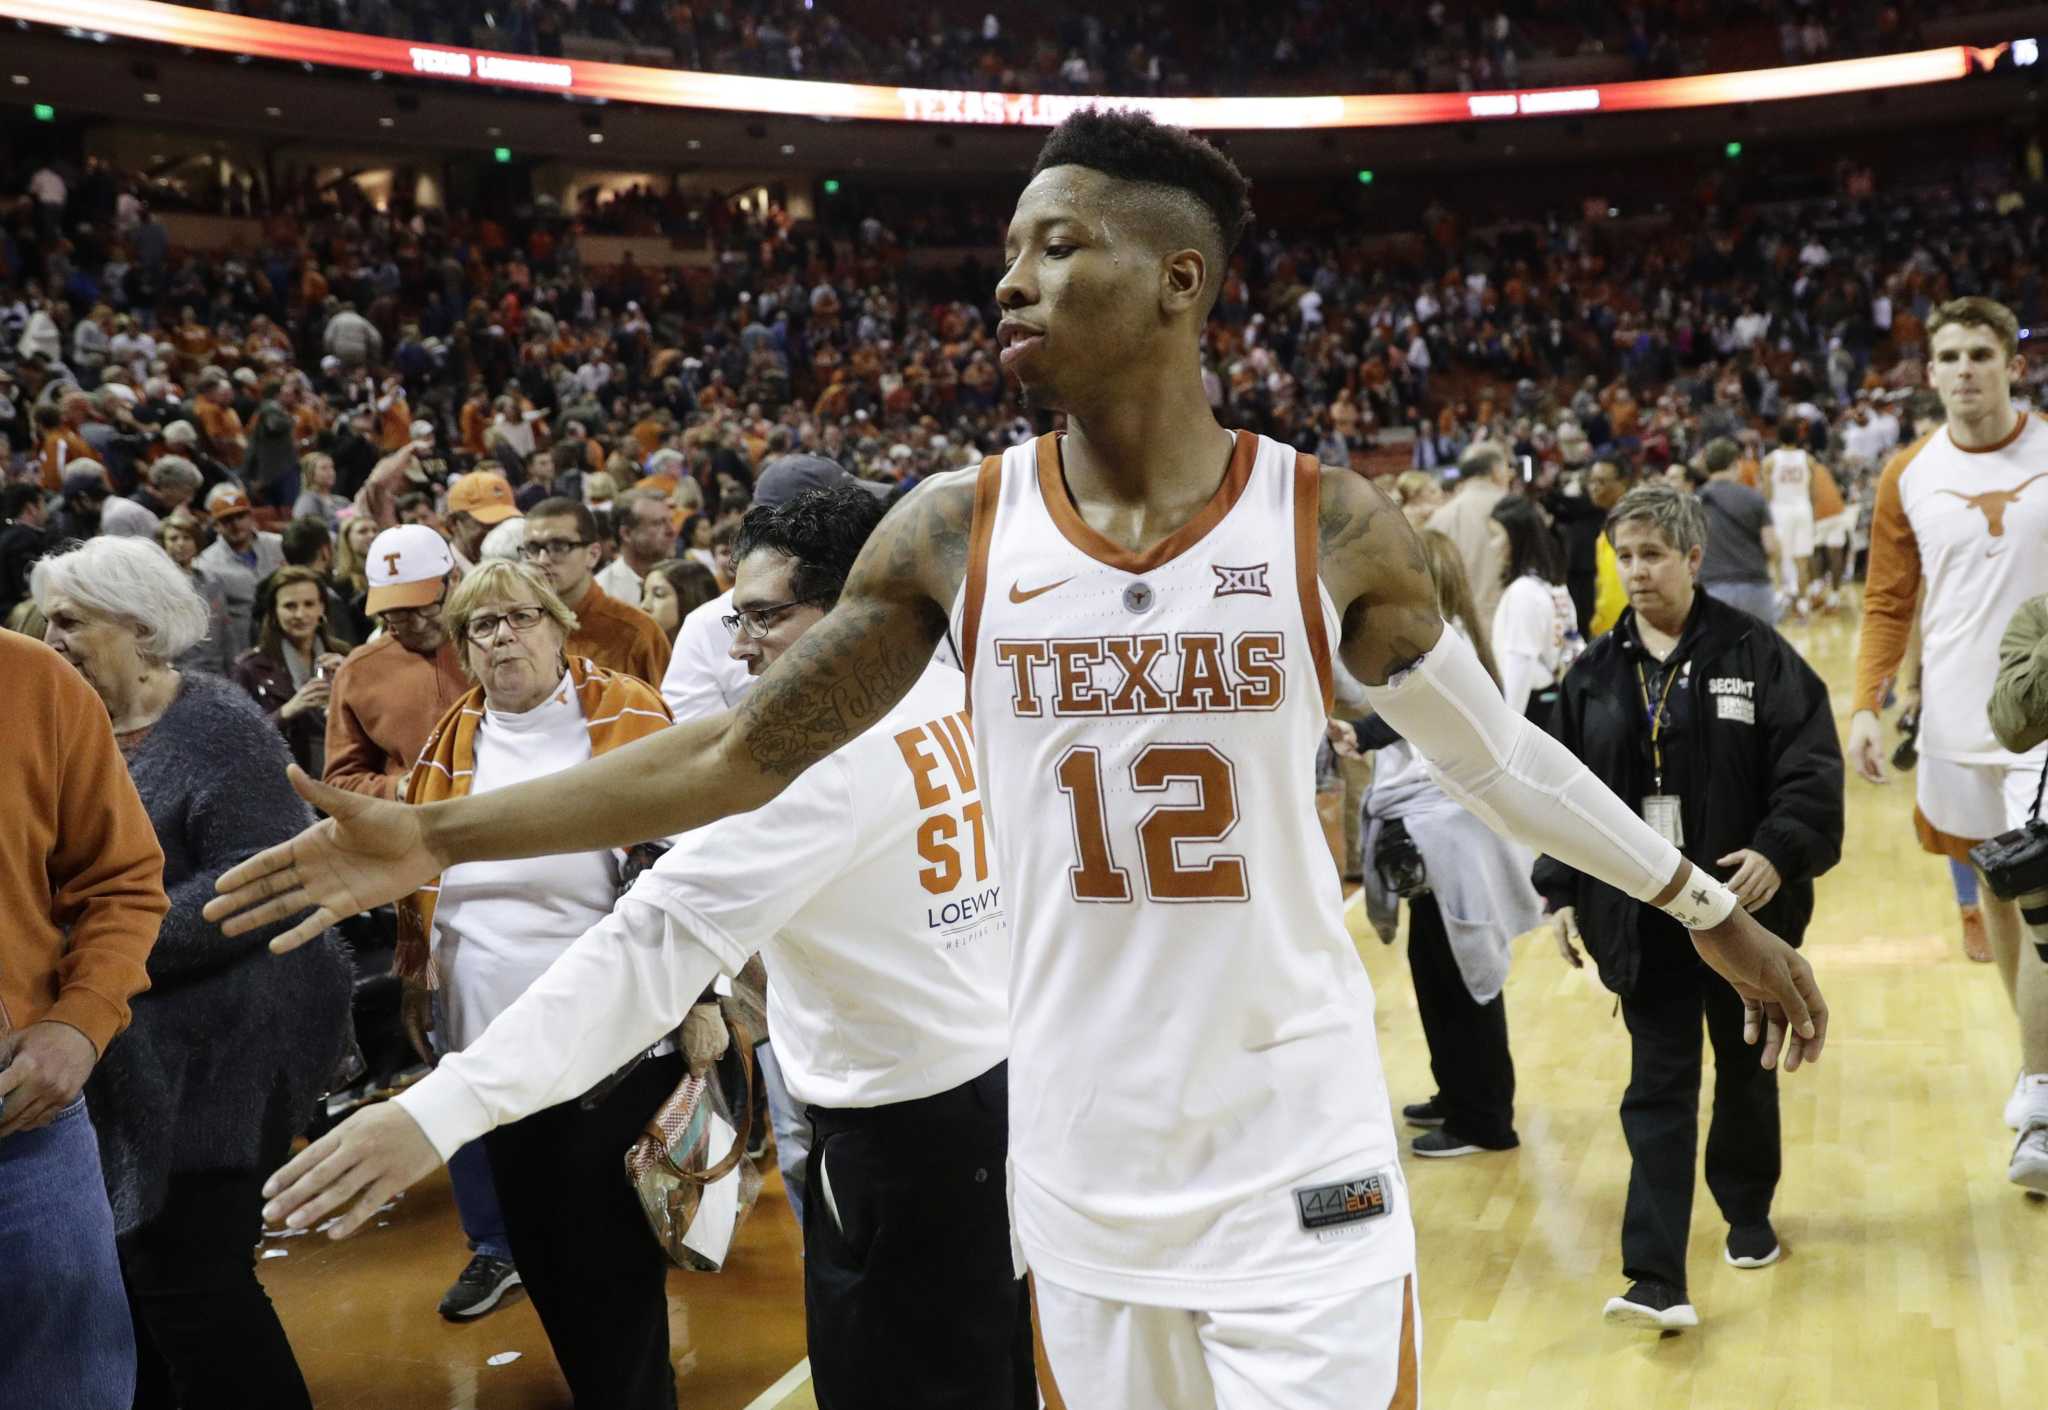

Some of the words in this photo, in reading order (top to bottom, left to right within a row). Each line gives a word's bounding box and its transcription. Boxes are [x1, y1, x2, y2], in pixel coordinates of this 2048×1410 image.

[383, 551, 401, 577] T
[994, 631, 1287, 718] TEXAS
[1055, 742, 1251, 903] 12
[928, 886, 1001, 929] LOEWY
[1305, 1189, 1343, 1213] 44
[1344, 1176, 1380, 1198] NIKE
